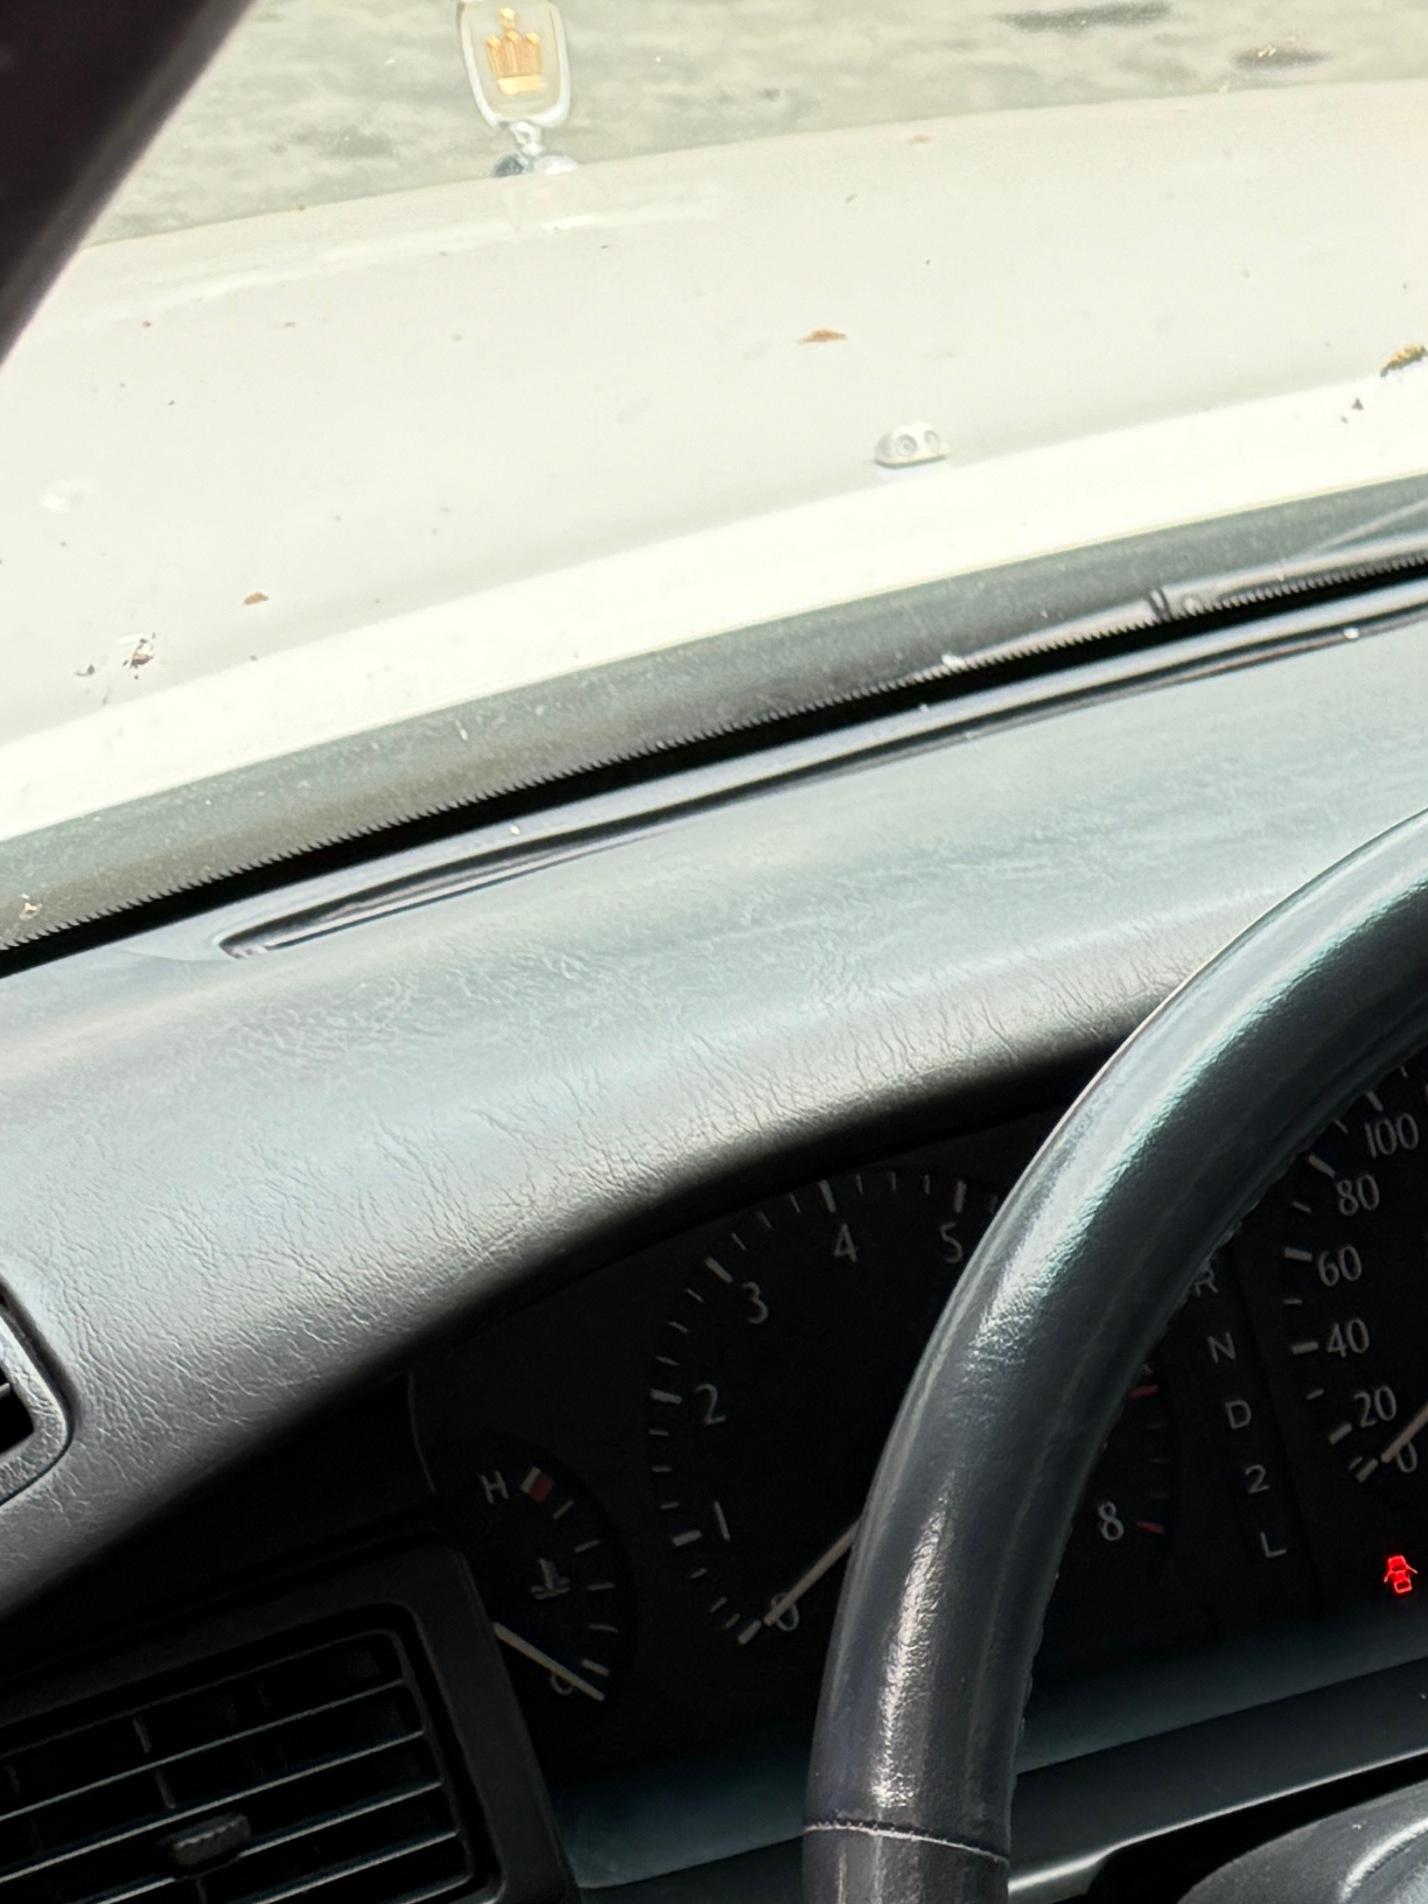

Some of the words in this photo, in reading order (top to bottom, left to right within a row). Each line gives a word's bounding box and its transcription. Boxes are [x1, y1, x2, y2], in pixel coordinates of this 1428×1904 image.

[1364, 1112, 1421, 1159] 100
[1335, 1172, 1381, 1217] 80
[832, 1223, 858, 1263] 4
[939, 1222, 964, 1264] 5
[1317, 1243, 1363, 1287] 60
[741, 1281, 770, 1326] 3
[1325, 1316, 1371, 1360] 40
[696, 1383, 727, 1427] 2
[1356, 1384, 1398, 1429] 20
[1207, 1332, 1238, 1364] N
[1225, 1400, 1252, 1430] D
[1244, 1464, 1271, 1495] 2
[1259, 1528, 1287, 1560] L
[476, 1469, 510, 1503] H
[1099, 1500, 1124, 1542] 8
